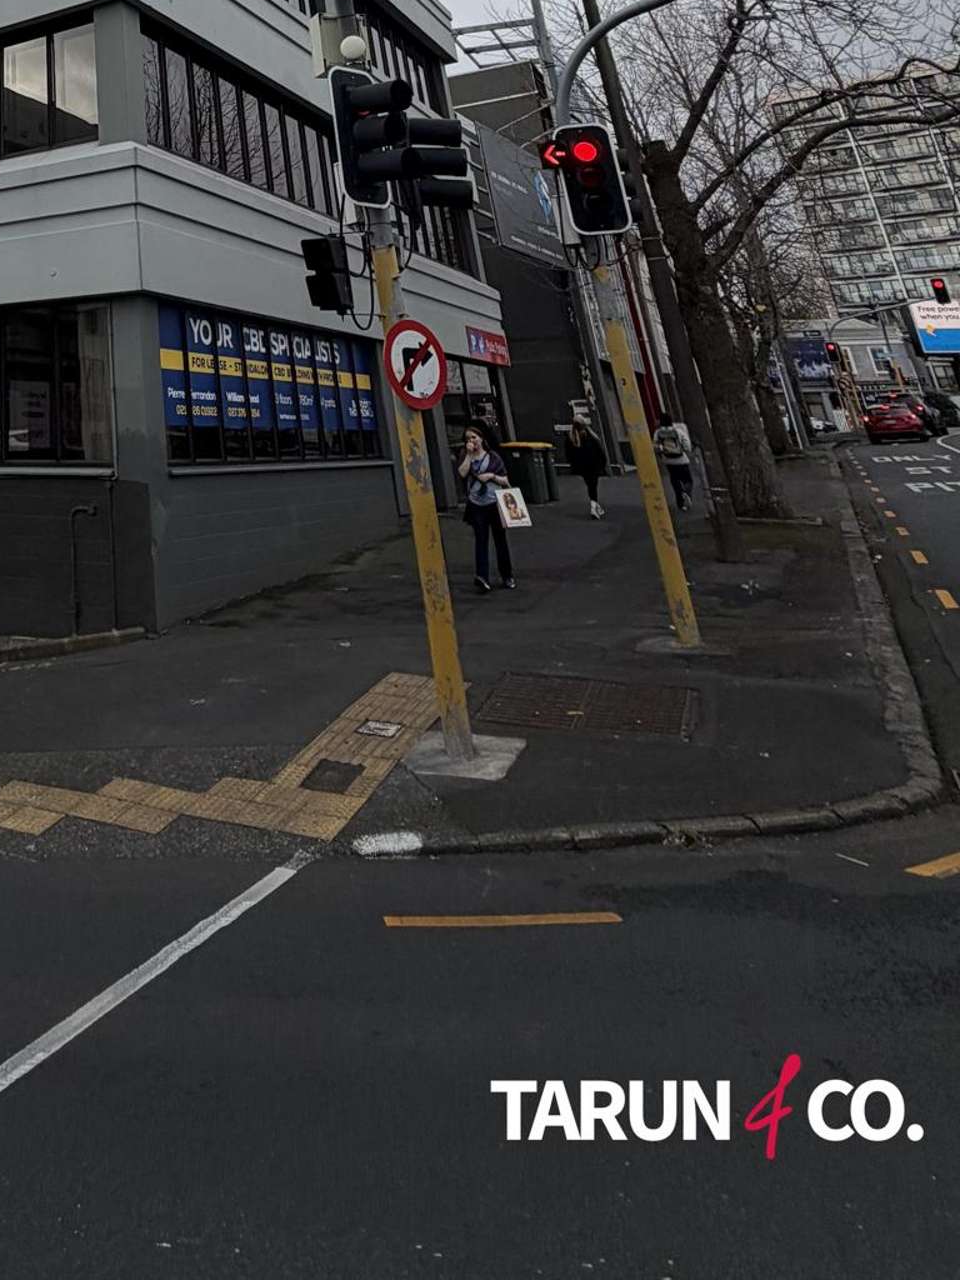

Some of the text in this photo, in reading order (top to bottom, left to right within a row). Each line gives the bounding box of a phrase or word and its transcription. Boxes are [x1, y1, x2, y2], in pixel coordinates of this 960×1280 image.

[206, 358, 227, 371] LESE
[872, 454, 953, 463] ONLY
[904, 465, 952, 475] ST
